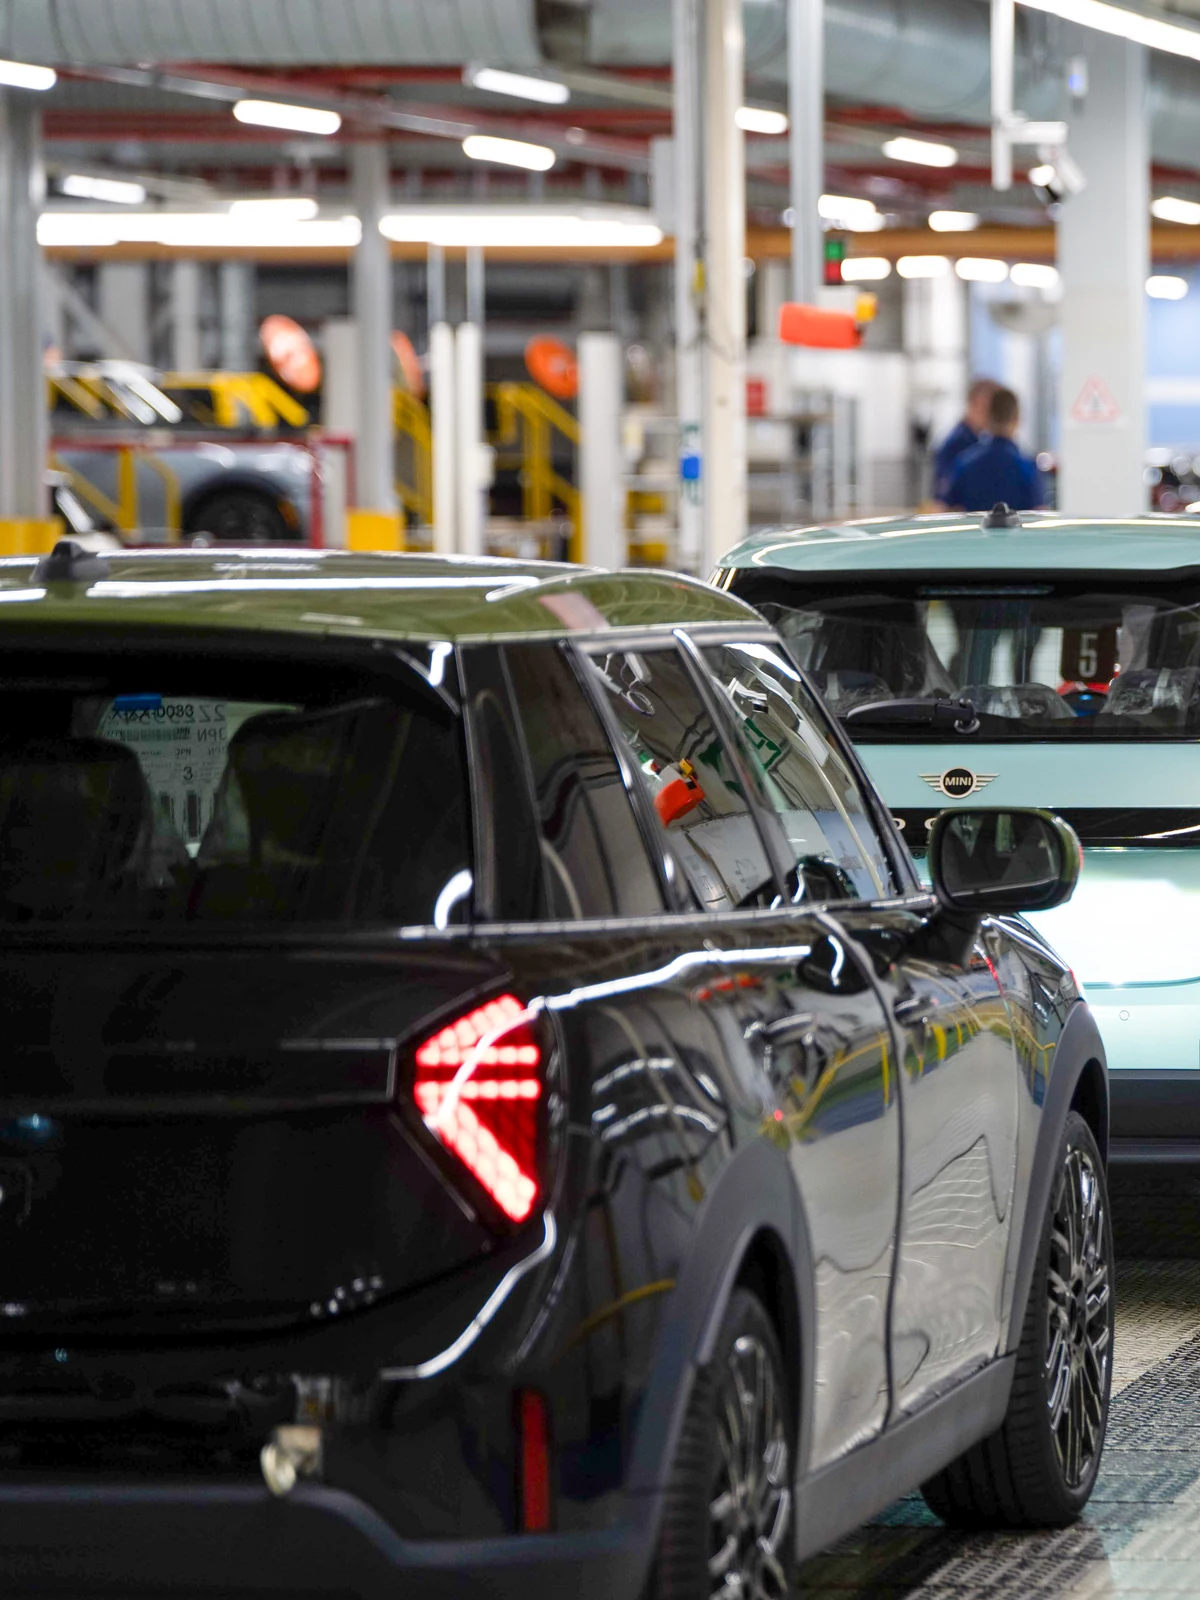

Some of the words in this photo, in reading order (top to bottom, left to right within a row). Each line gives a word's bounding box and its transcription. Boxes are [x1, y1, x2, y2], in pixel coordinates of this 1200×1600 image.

[1079, 633, 1098, 678] 5
[183, 766, 193, 781] 3
[945, 776, 971, 786] MINI
